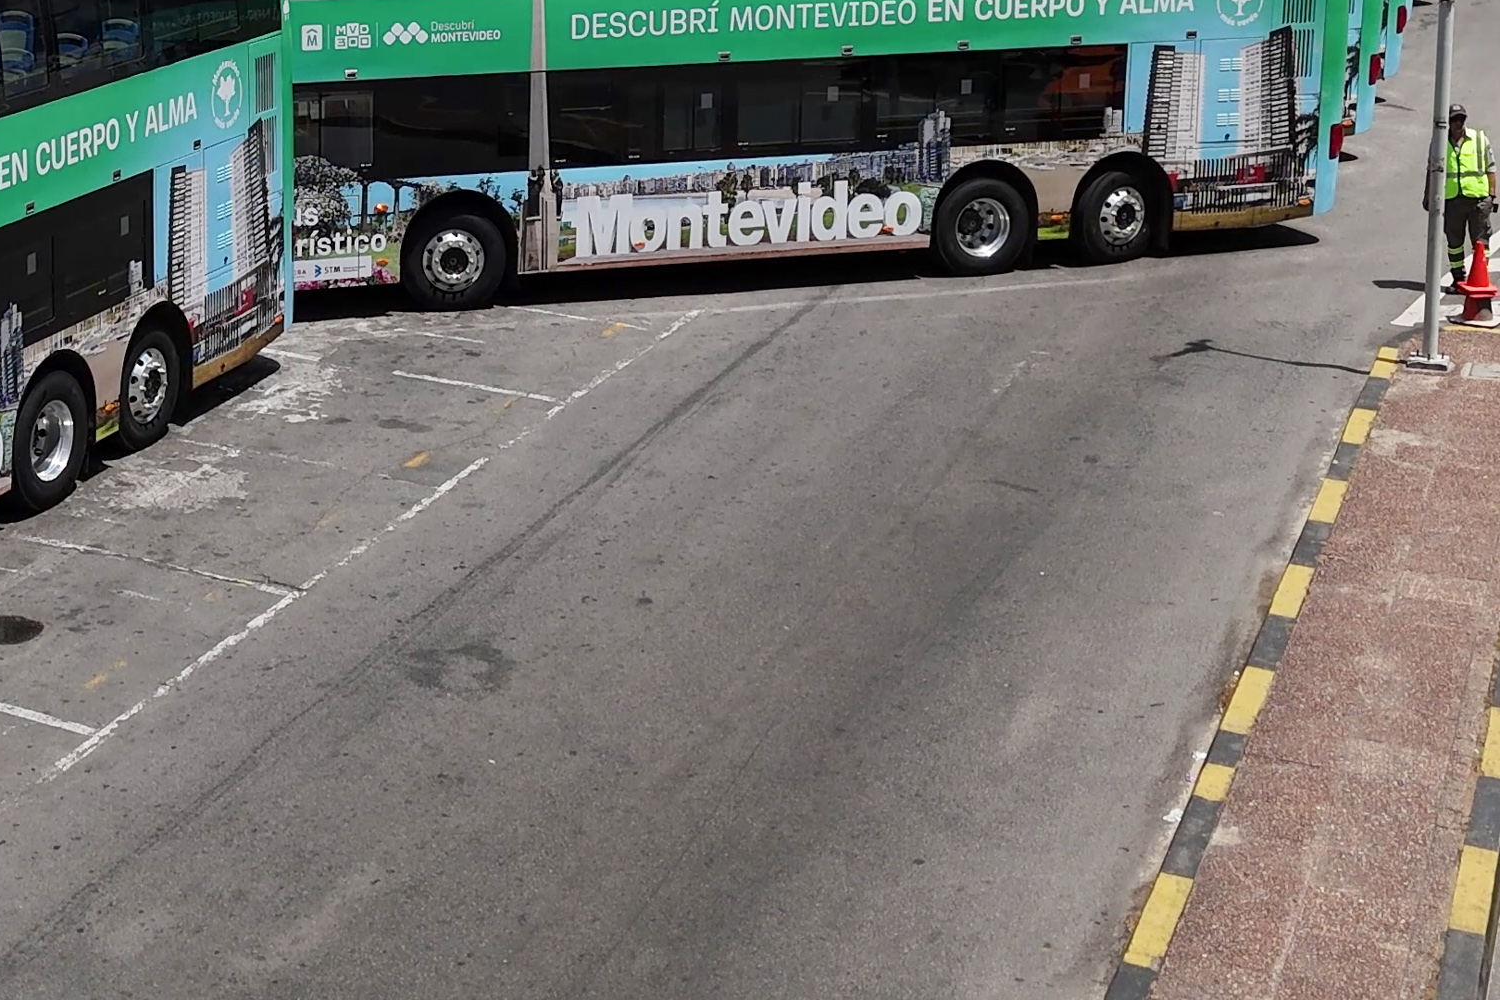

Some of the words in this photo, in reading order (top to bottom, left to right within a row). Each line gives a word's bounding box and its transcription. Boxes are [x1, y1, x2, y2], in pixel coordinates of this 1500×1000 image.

[430, 19, 475, 32] Descubrí
[430, 30, 501, 43] MONTEVIDEO
[570, 0, 720, 41] DESCUBRÍ
[35, 117, 120, 176] CUERPO
[125, 110, 140, 143] Y
[144, 92, 198, 138] ALMA
[561, 180, 922, 258] Montevideo
[295, 225, 387, 258] rístico
[324, 266, 341, 275] STM
